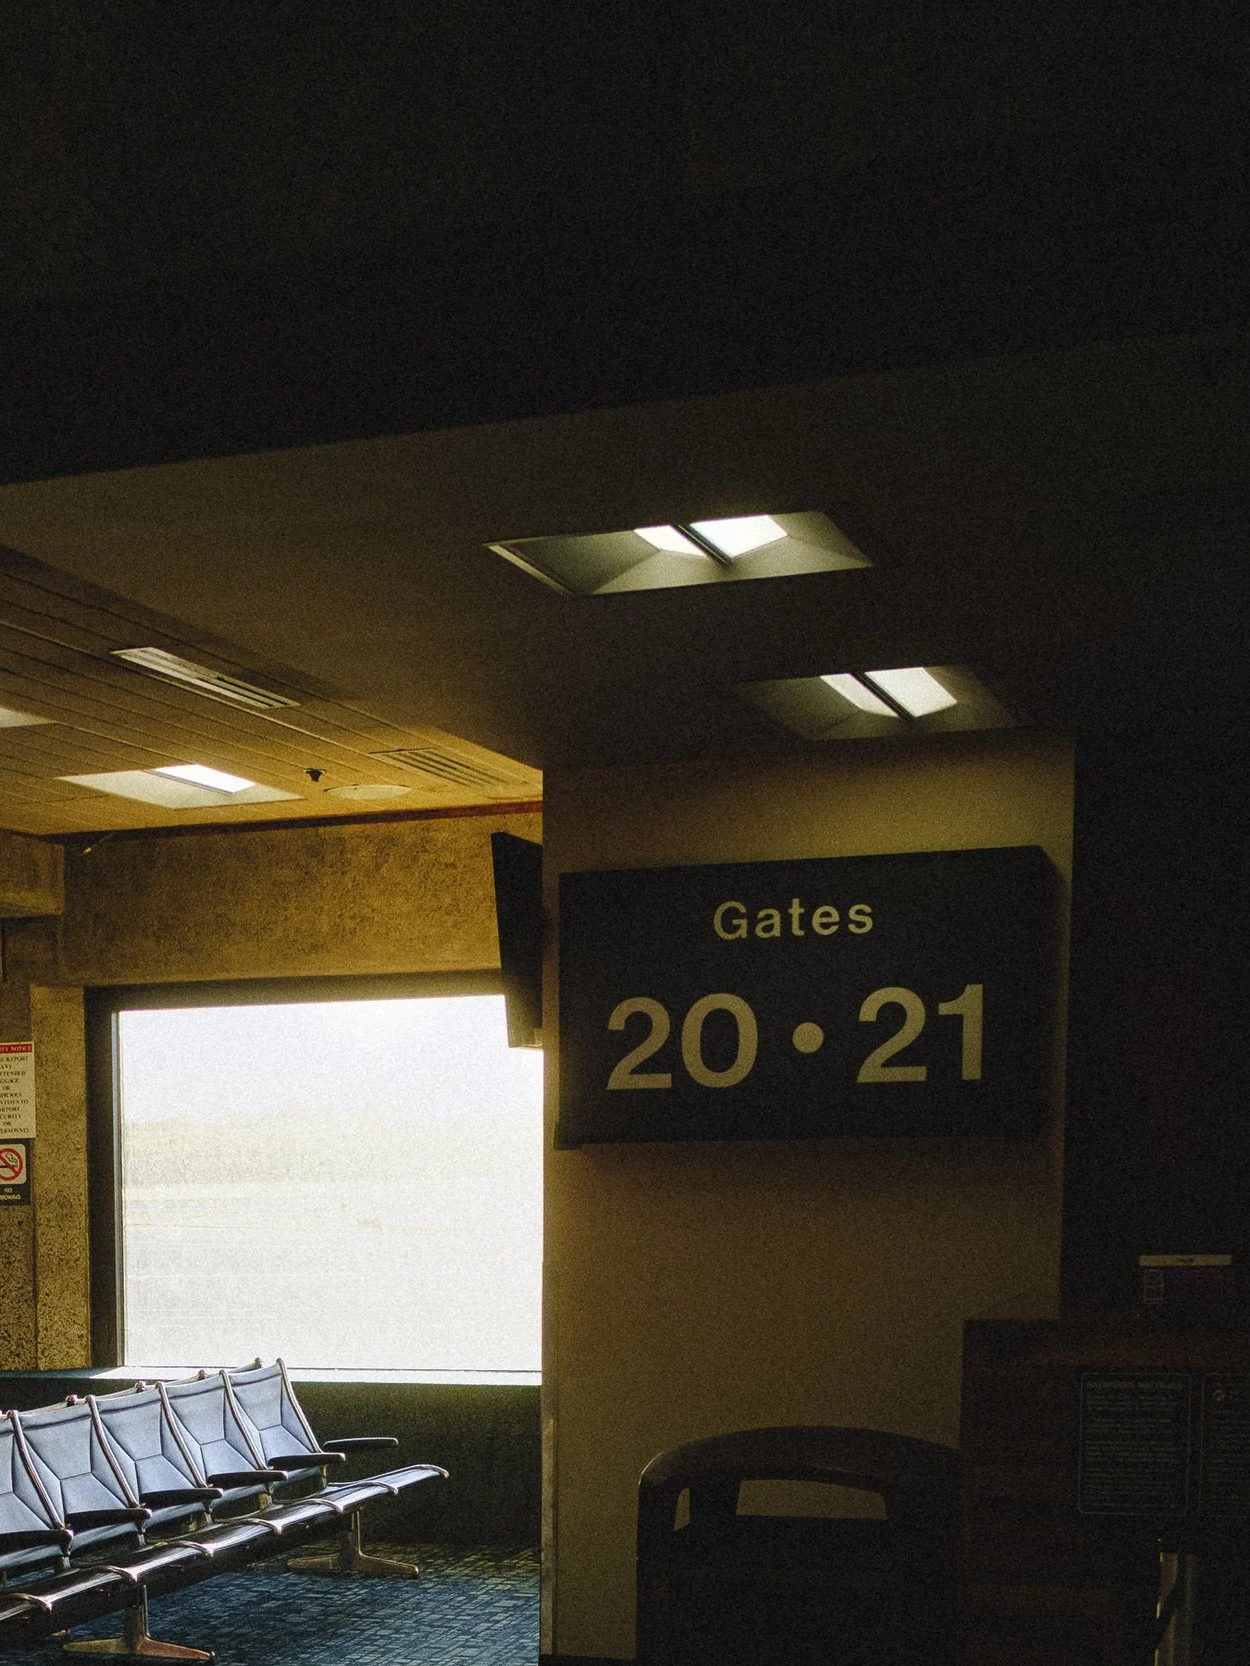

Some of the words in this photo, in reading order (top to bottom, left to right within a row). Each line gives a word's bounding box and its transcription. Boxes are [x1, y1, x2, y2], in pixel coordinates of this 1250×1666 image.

[713, 898, 874, 940] Gates
[606, 993, 758, 1090] 20
[857, 984, 984, 1084] 21
